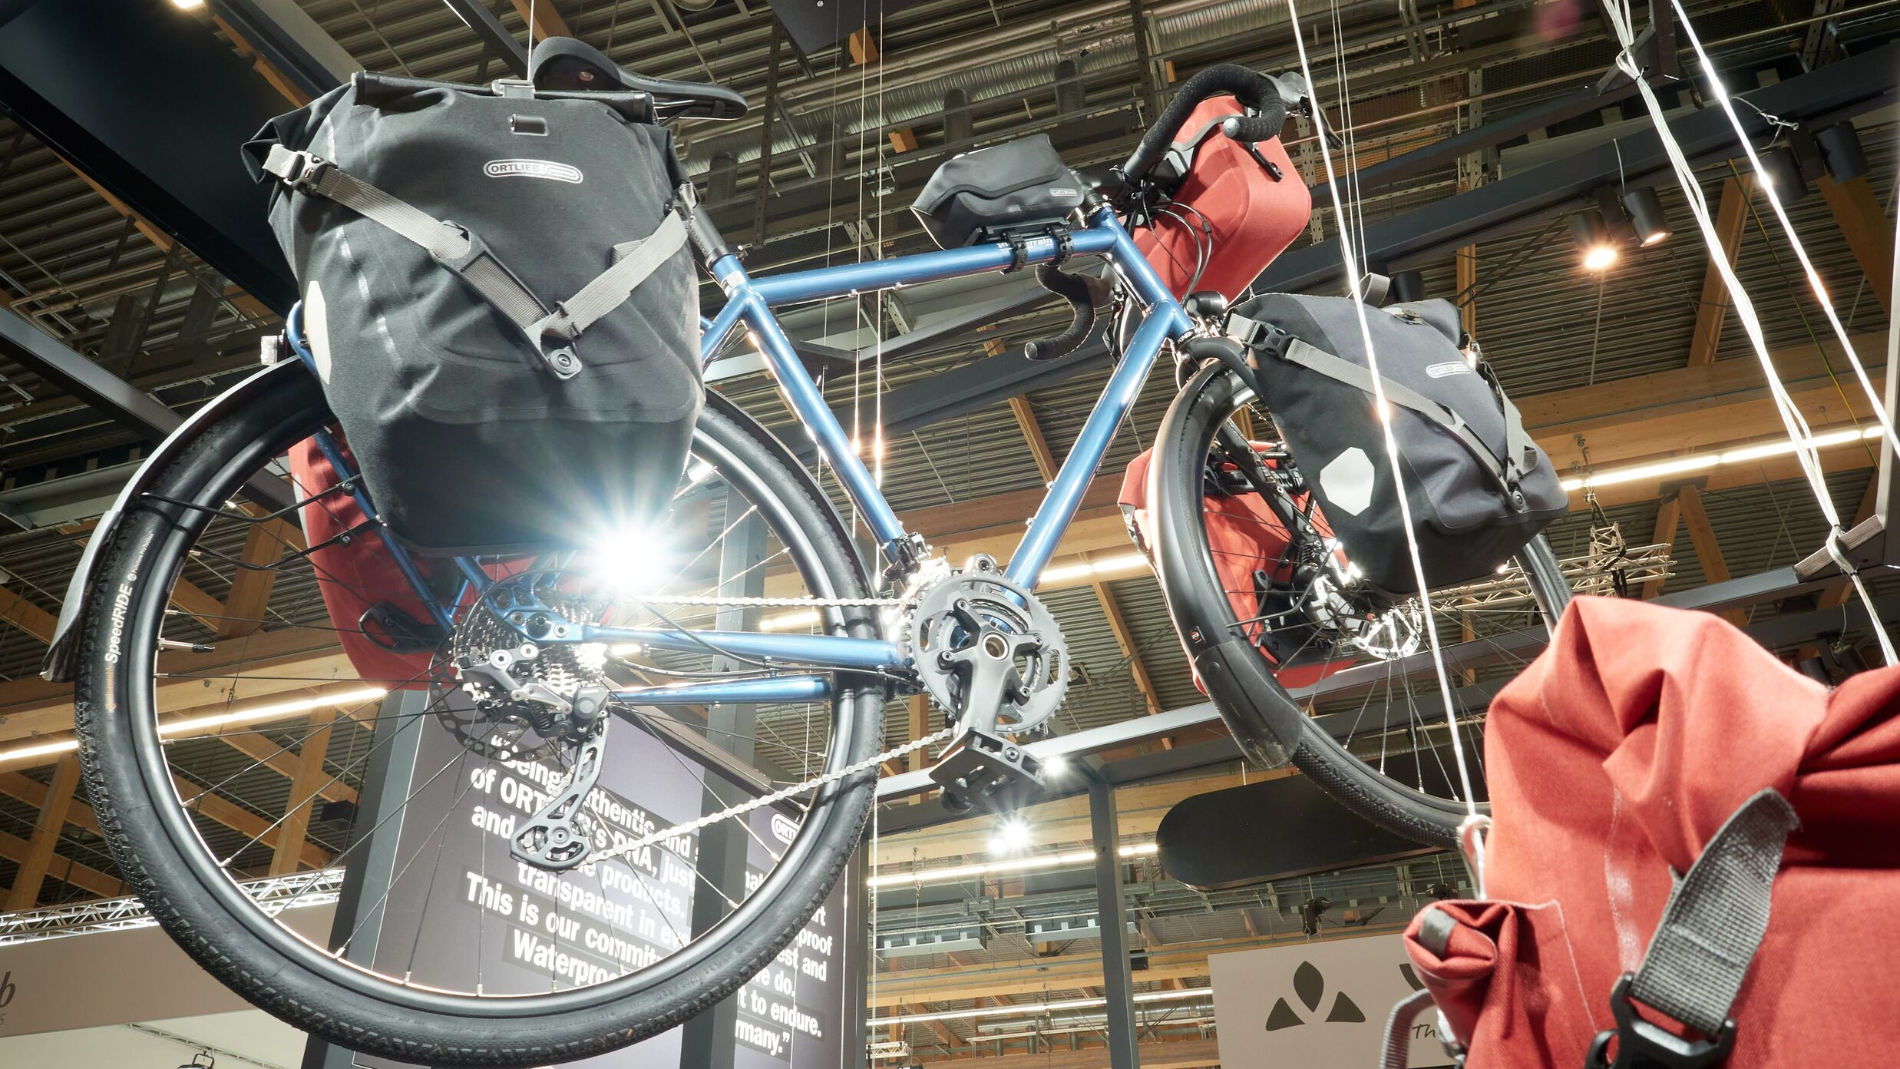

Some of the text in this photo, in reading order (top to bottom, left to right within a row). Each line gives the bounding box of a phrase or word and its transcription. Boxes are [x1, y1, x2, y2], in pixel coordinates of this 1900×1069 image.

[105, 584, 132, 664] SpeedRIDE
[470, 767, 497, 794] of
[582, 787, 655, 838] thentic
[471, 805, 687, 919] and products.
[466, 871, 662, 969] This is our commit
[518, 860, 634, 929] transparent
[638, 908, 657, 939] in
[513, 928, 624, 987] Waterpro
[797, 927, 833, 957] proof
[774, 968, 796, 998] do.
[802, 956, 827, 982] and
[734, 1019, 791, 1057] rmany.”
[751, 989, 767, 1016] to
[771, 1001, 822, 1038] endure.
